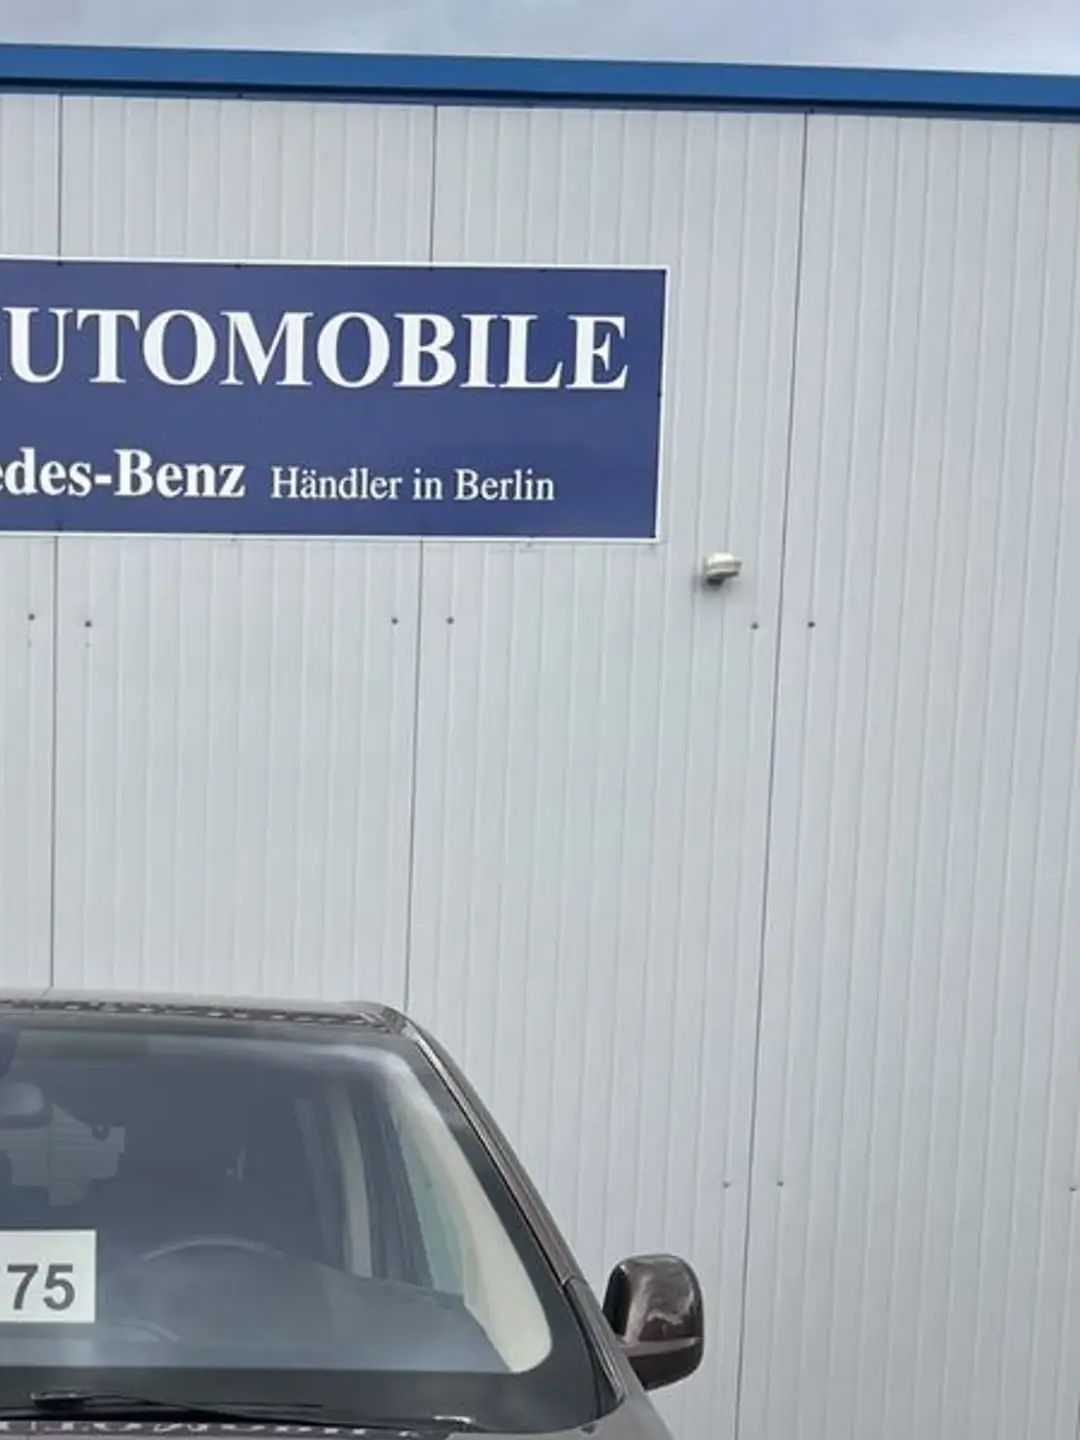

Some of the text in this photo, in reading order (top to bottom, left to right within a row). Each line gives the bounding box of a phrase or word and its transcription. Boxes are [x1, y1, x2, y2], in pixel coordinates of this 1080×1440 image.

[270, 466, 403, 501] Händler
[412, 467, 443, 501] in
[454, 468, 555, 501] Berlin
